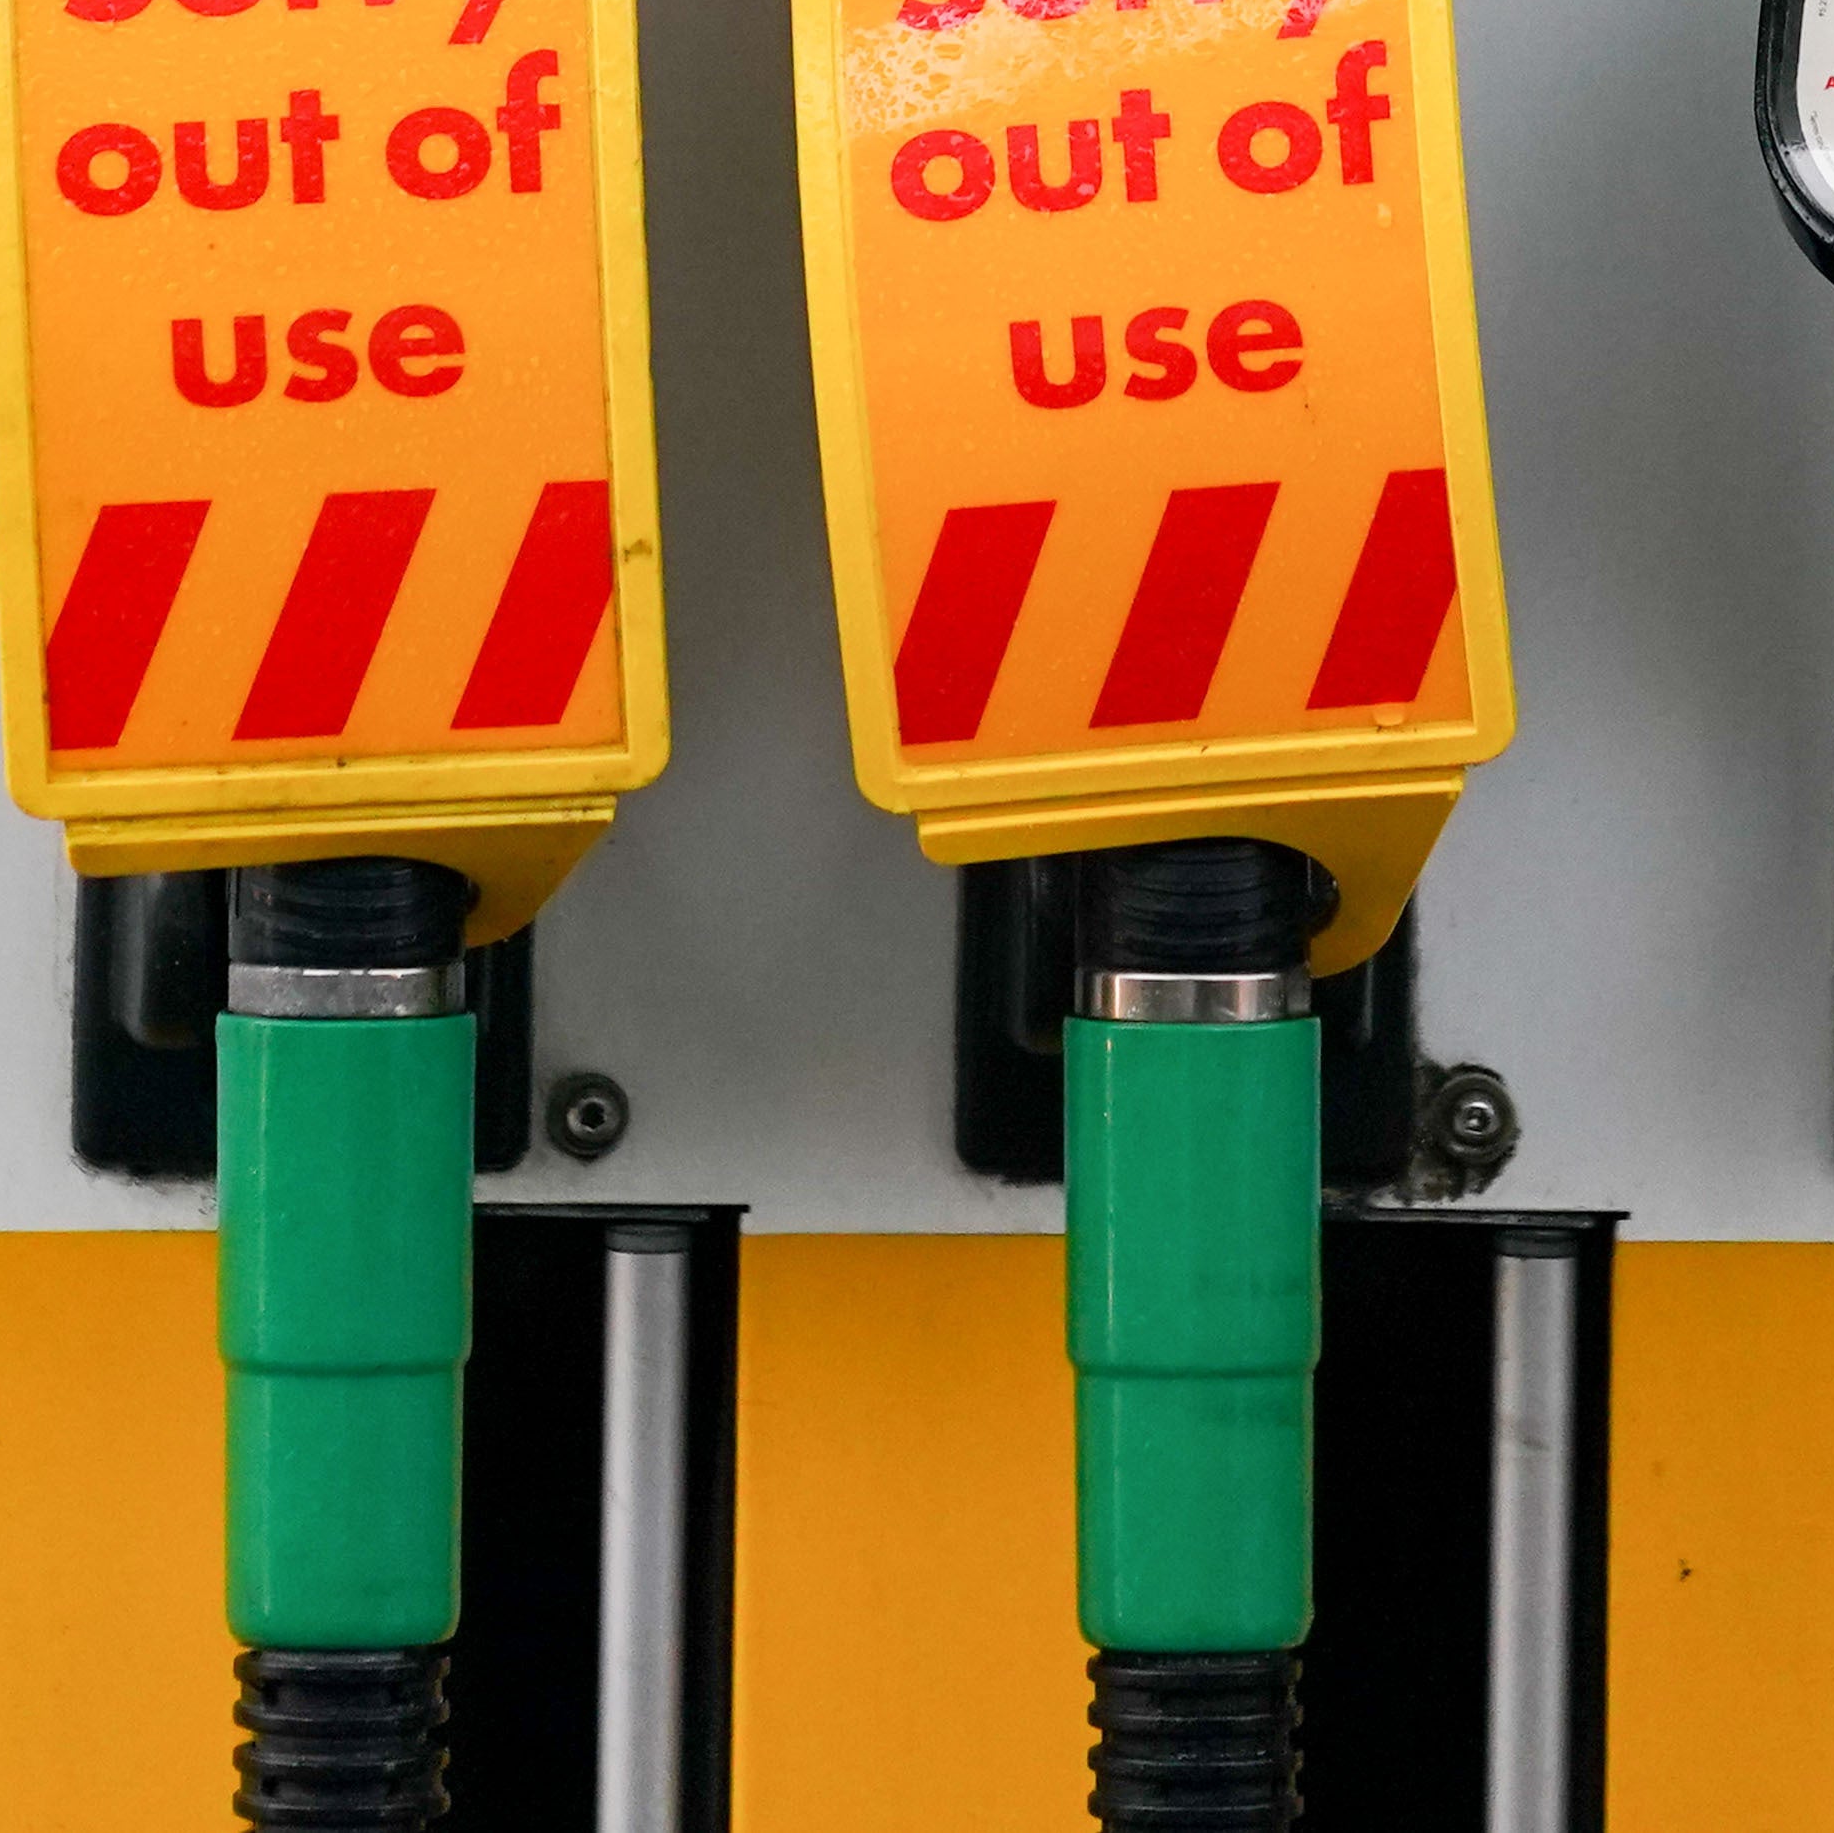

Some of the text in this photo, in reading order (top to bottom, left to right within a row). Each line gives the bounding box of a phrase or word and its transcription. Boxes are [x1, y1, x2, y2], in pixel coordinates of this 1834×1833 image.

[56, 50, 561, 216] out of
[891, 40, 1390, 221] out of
[172, 304, 465, 407] use
[1009, 299, 1304, 409] use
